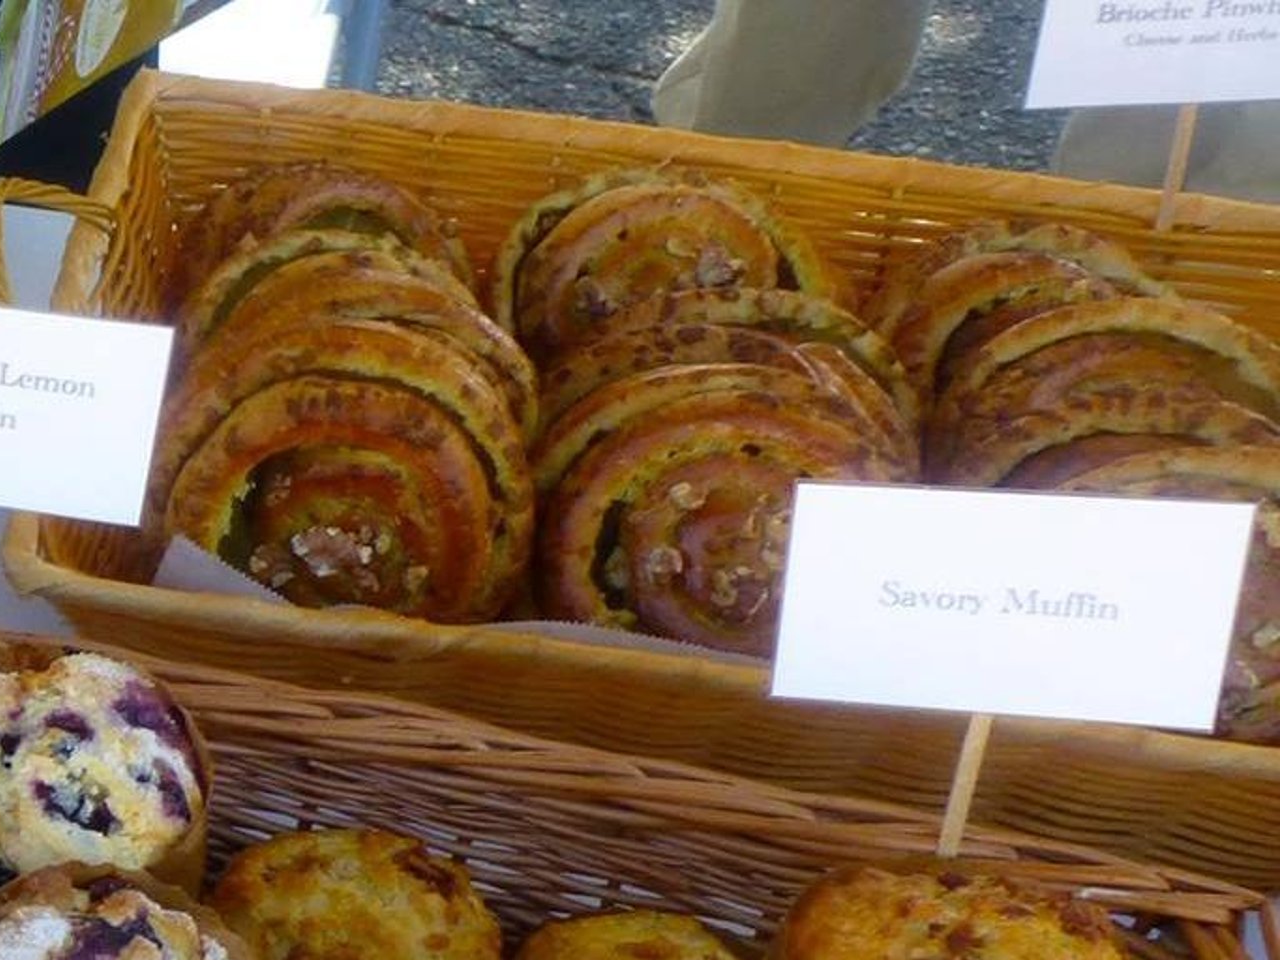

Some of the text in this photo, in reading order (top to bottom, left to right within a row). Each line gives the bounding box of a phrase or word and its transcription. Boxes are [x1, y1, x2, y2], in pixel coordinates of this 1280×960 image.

[1097, 1, 1193, 24] Brioche
[0, 363, 96, 398] Lemon
[877, 580, 1120, 622] Savory Muffin
